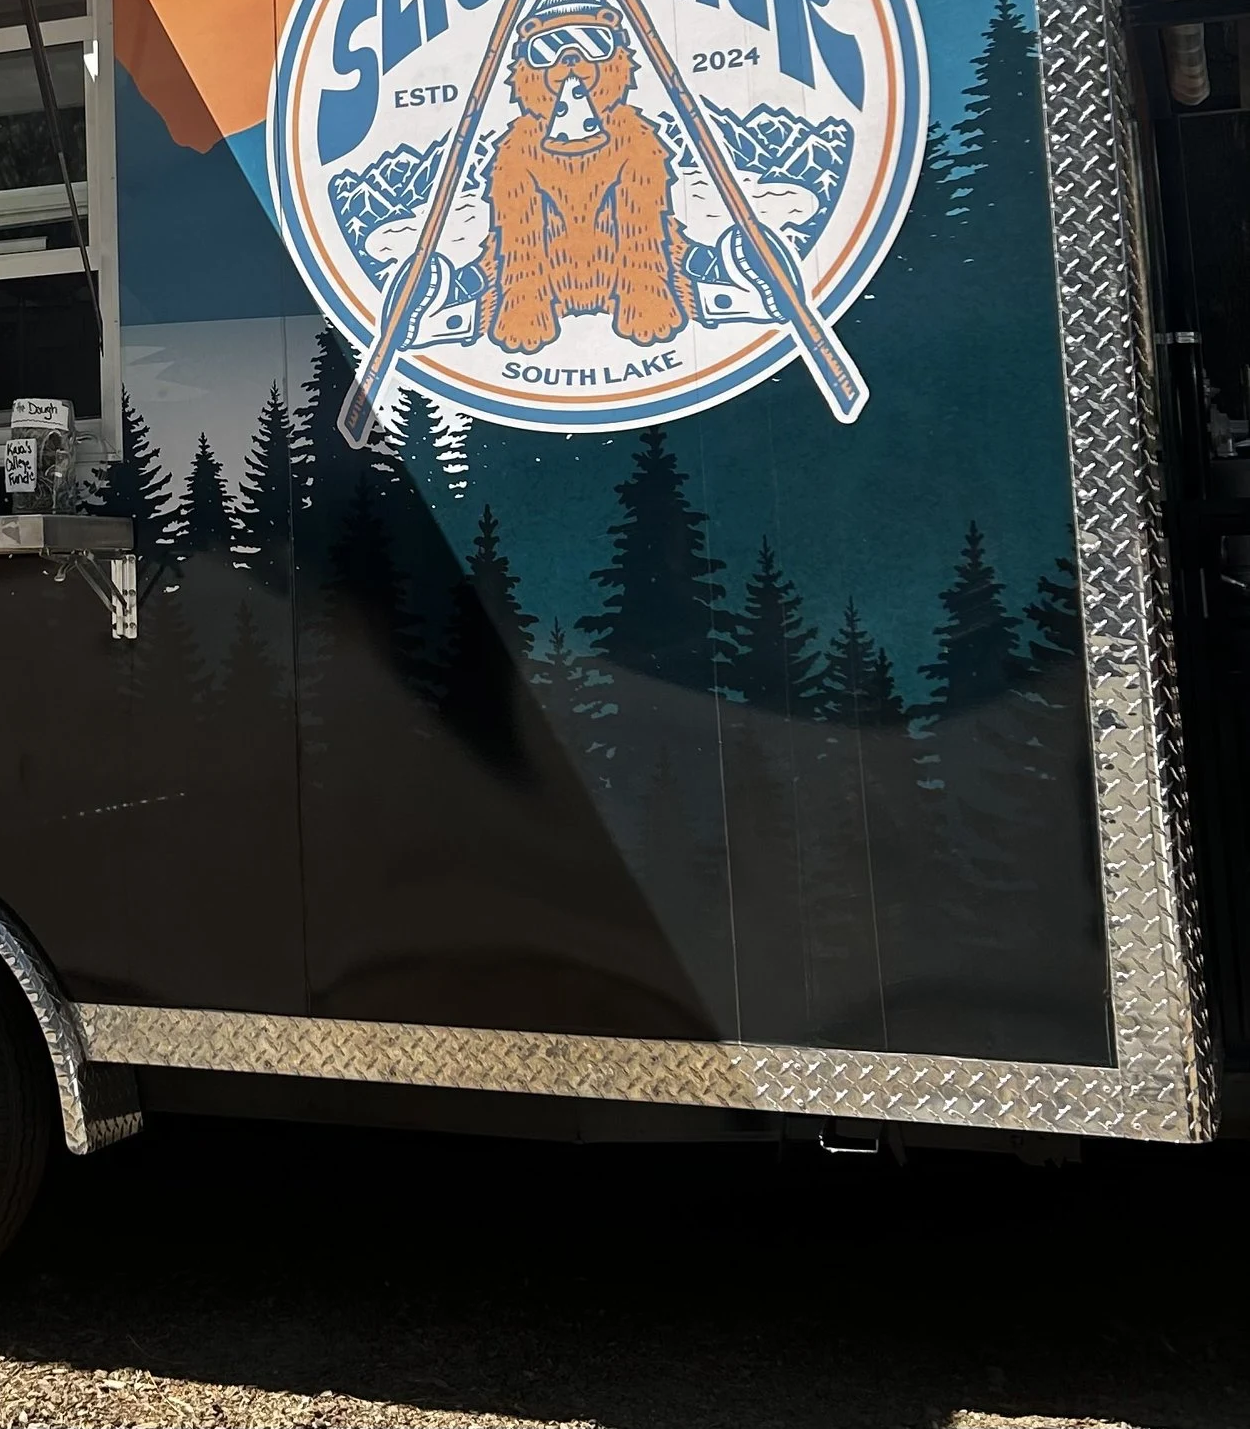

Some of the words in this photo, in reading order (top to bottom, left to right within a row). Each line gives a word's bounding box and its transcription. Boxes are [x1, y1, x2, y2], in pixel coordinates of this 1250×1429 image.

[692, 47, 761, 73] 2024
[395, 84, 459, 109] ESTD
[501, 362, 597, 386] SOUTH
[603, 350, 684, 384] LAKE
[28, 402, 58, 420] Dough
